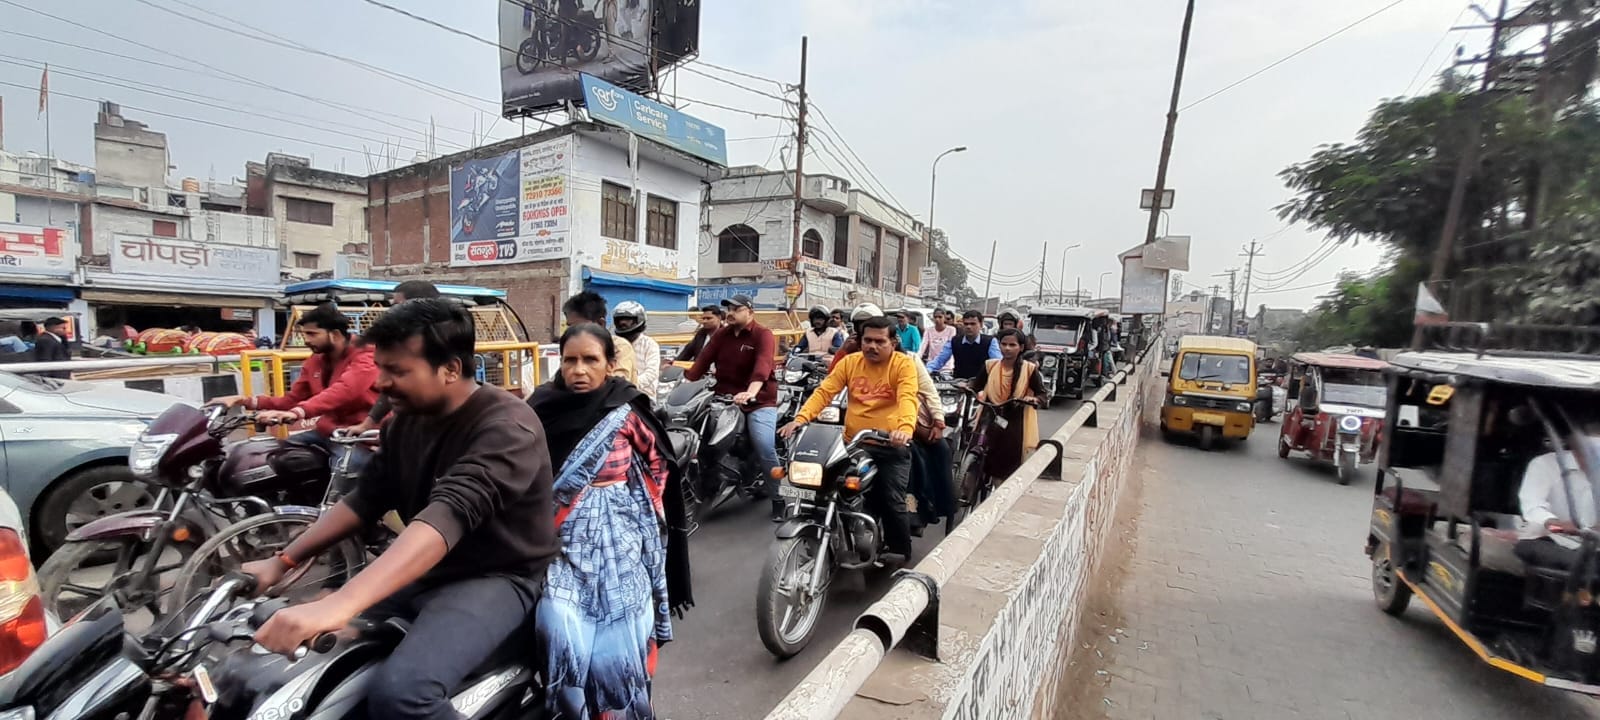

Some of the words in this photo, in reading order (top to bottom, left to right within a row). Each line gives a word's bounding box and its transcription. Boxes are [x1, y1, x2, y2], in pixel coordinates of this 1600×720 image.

[635, 112, 668, 131] Service
[551, 205, 568, 218] OPEN
[499, 243, 515, 258] TVS
